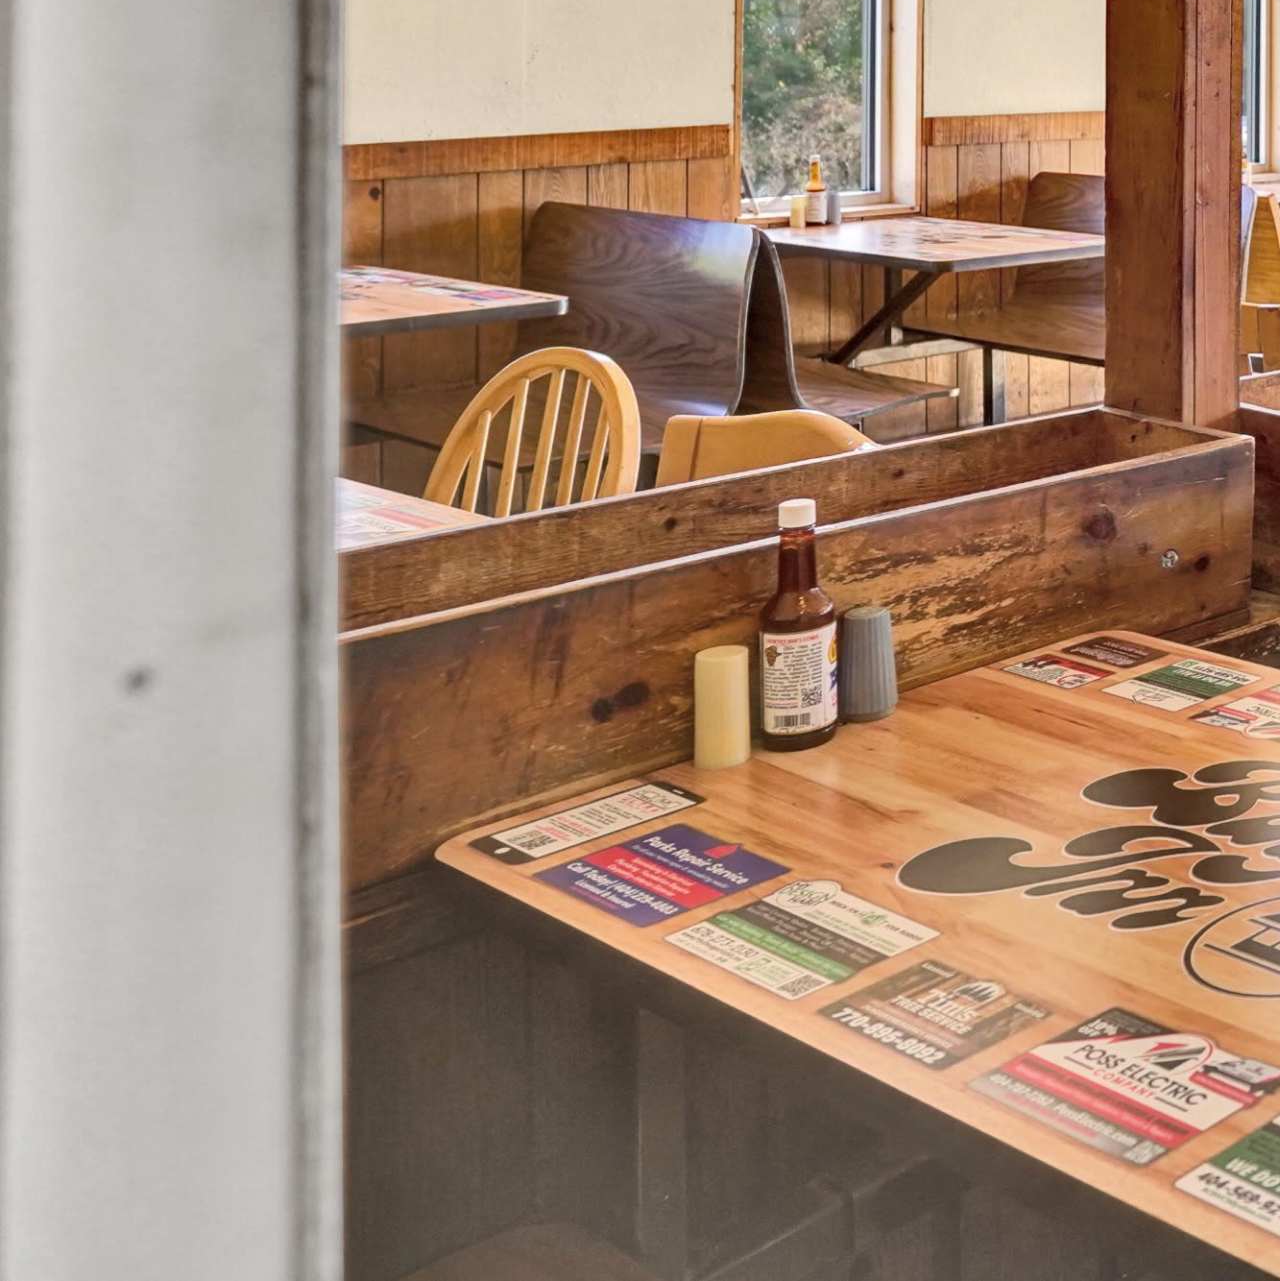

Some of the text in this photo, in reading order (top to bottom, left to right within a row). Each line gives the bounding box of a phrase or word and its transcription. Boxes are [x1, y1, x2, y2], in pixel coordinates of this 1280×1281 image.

[562, 861, 594, 874] Call
[640, 835, 683, 853] Parks
[665, 847, 716, 869] Repair
[701, 862, 756, 885] Service
[896, 824, 1225, 931] Inn
[887, 994, 927, 1013] TREE
[914, 1007, 974, 1036] SERVICE
[910, 987, 988, 1024] Tim's
[1071, 1042, 1211, 1107] POSS ELECTRIC
[1089, 1067, 1158, 1100] COMPANY
[1221, 1156, 1261, 1178] WE
